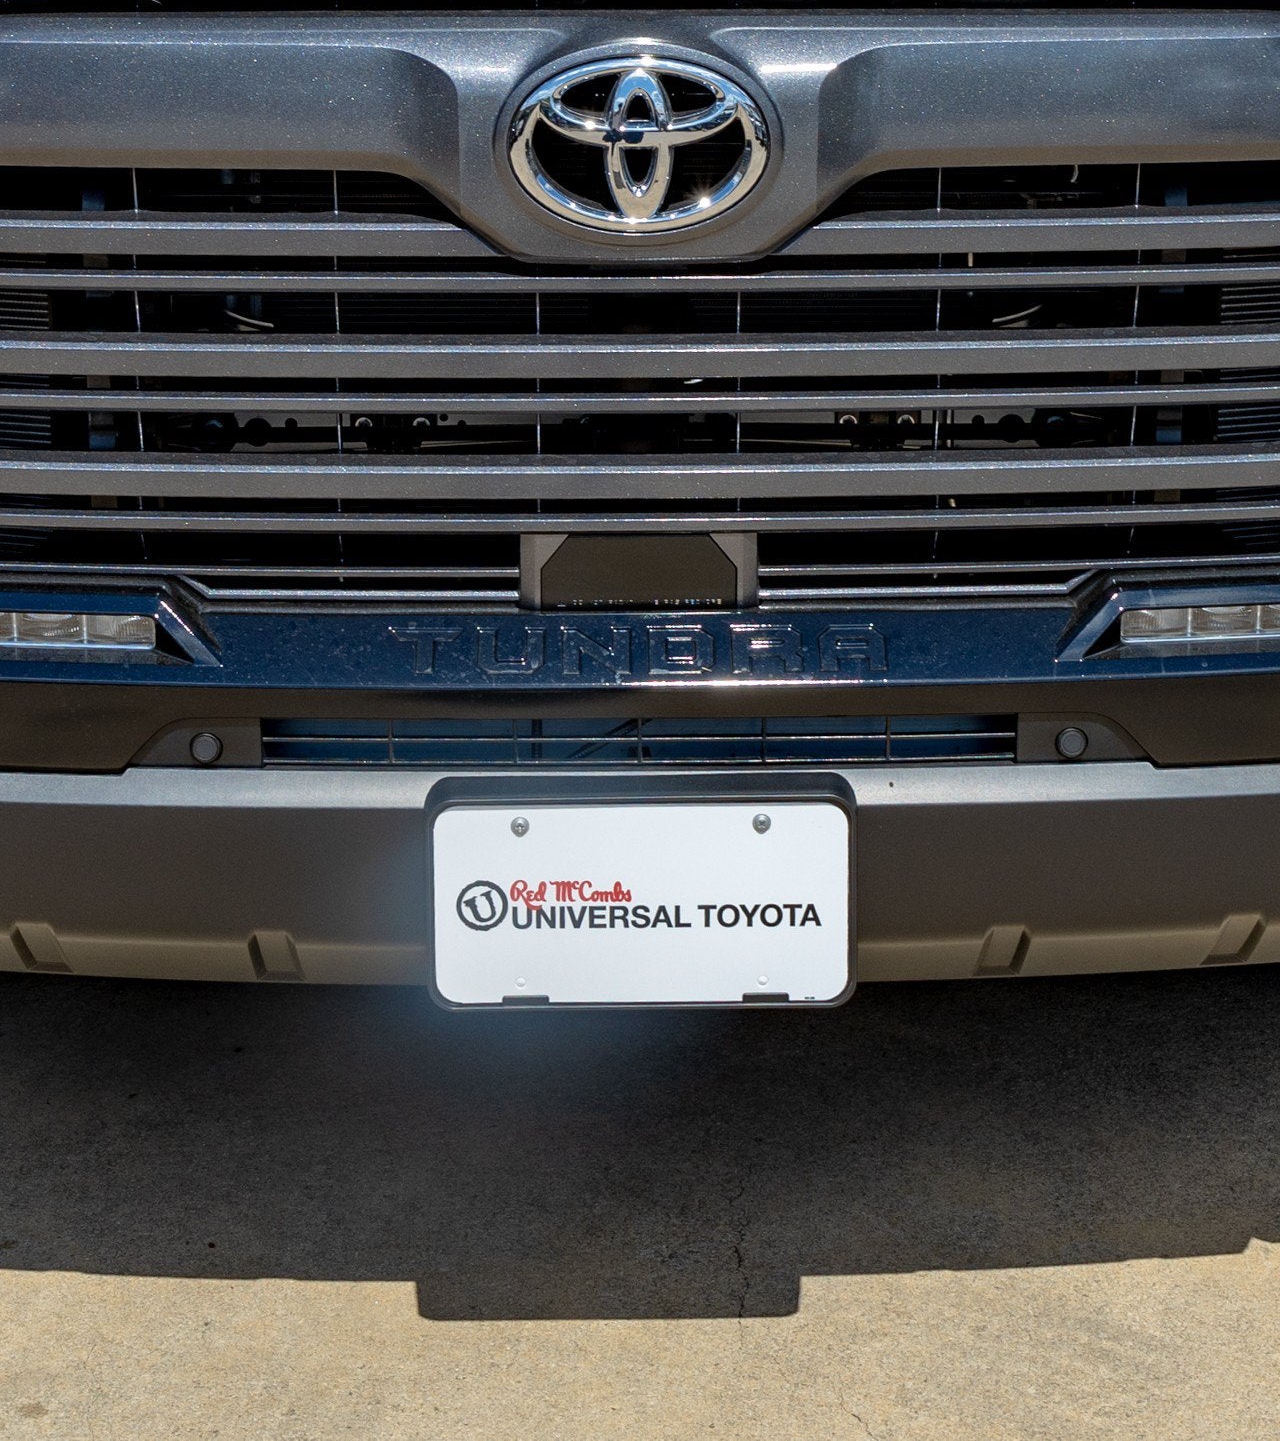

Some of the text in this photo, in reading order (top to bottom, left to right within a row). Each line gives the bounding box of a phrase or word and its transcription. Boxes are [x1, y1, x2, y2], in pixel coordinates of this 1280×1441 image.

[387, 622, 889, 676] TUNDRA
[509, 879, 547, 911] Red
[510, 905, 692, 929] UNIVERSAL
[698, 903, 823, 928] TOYOTA
